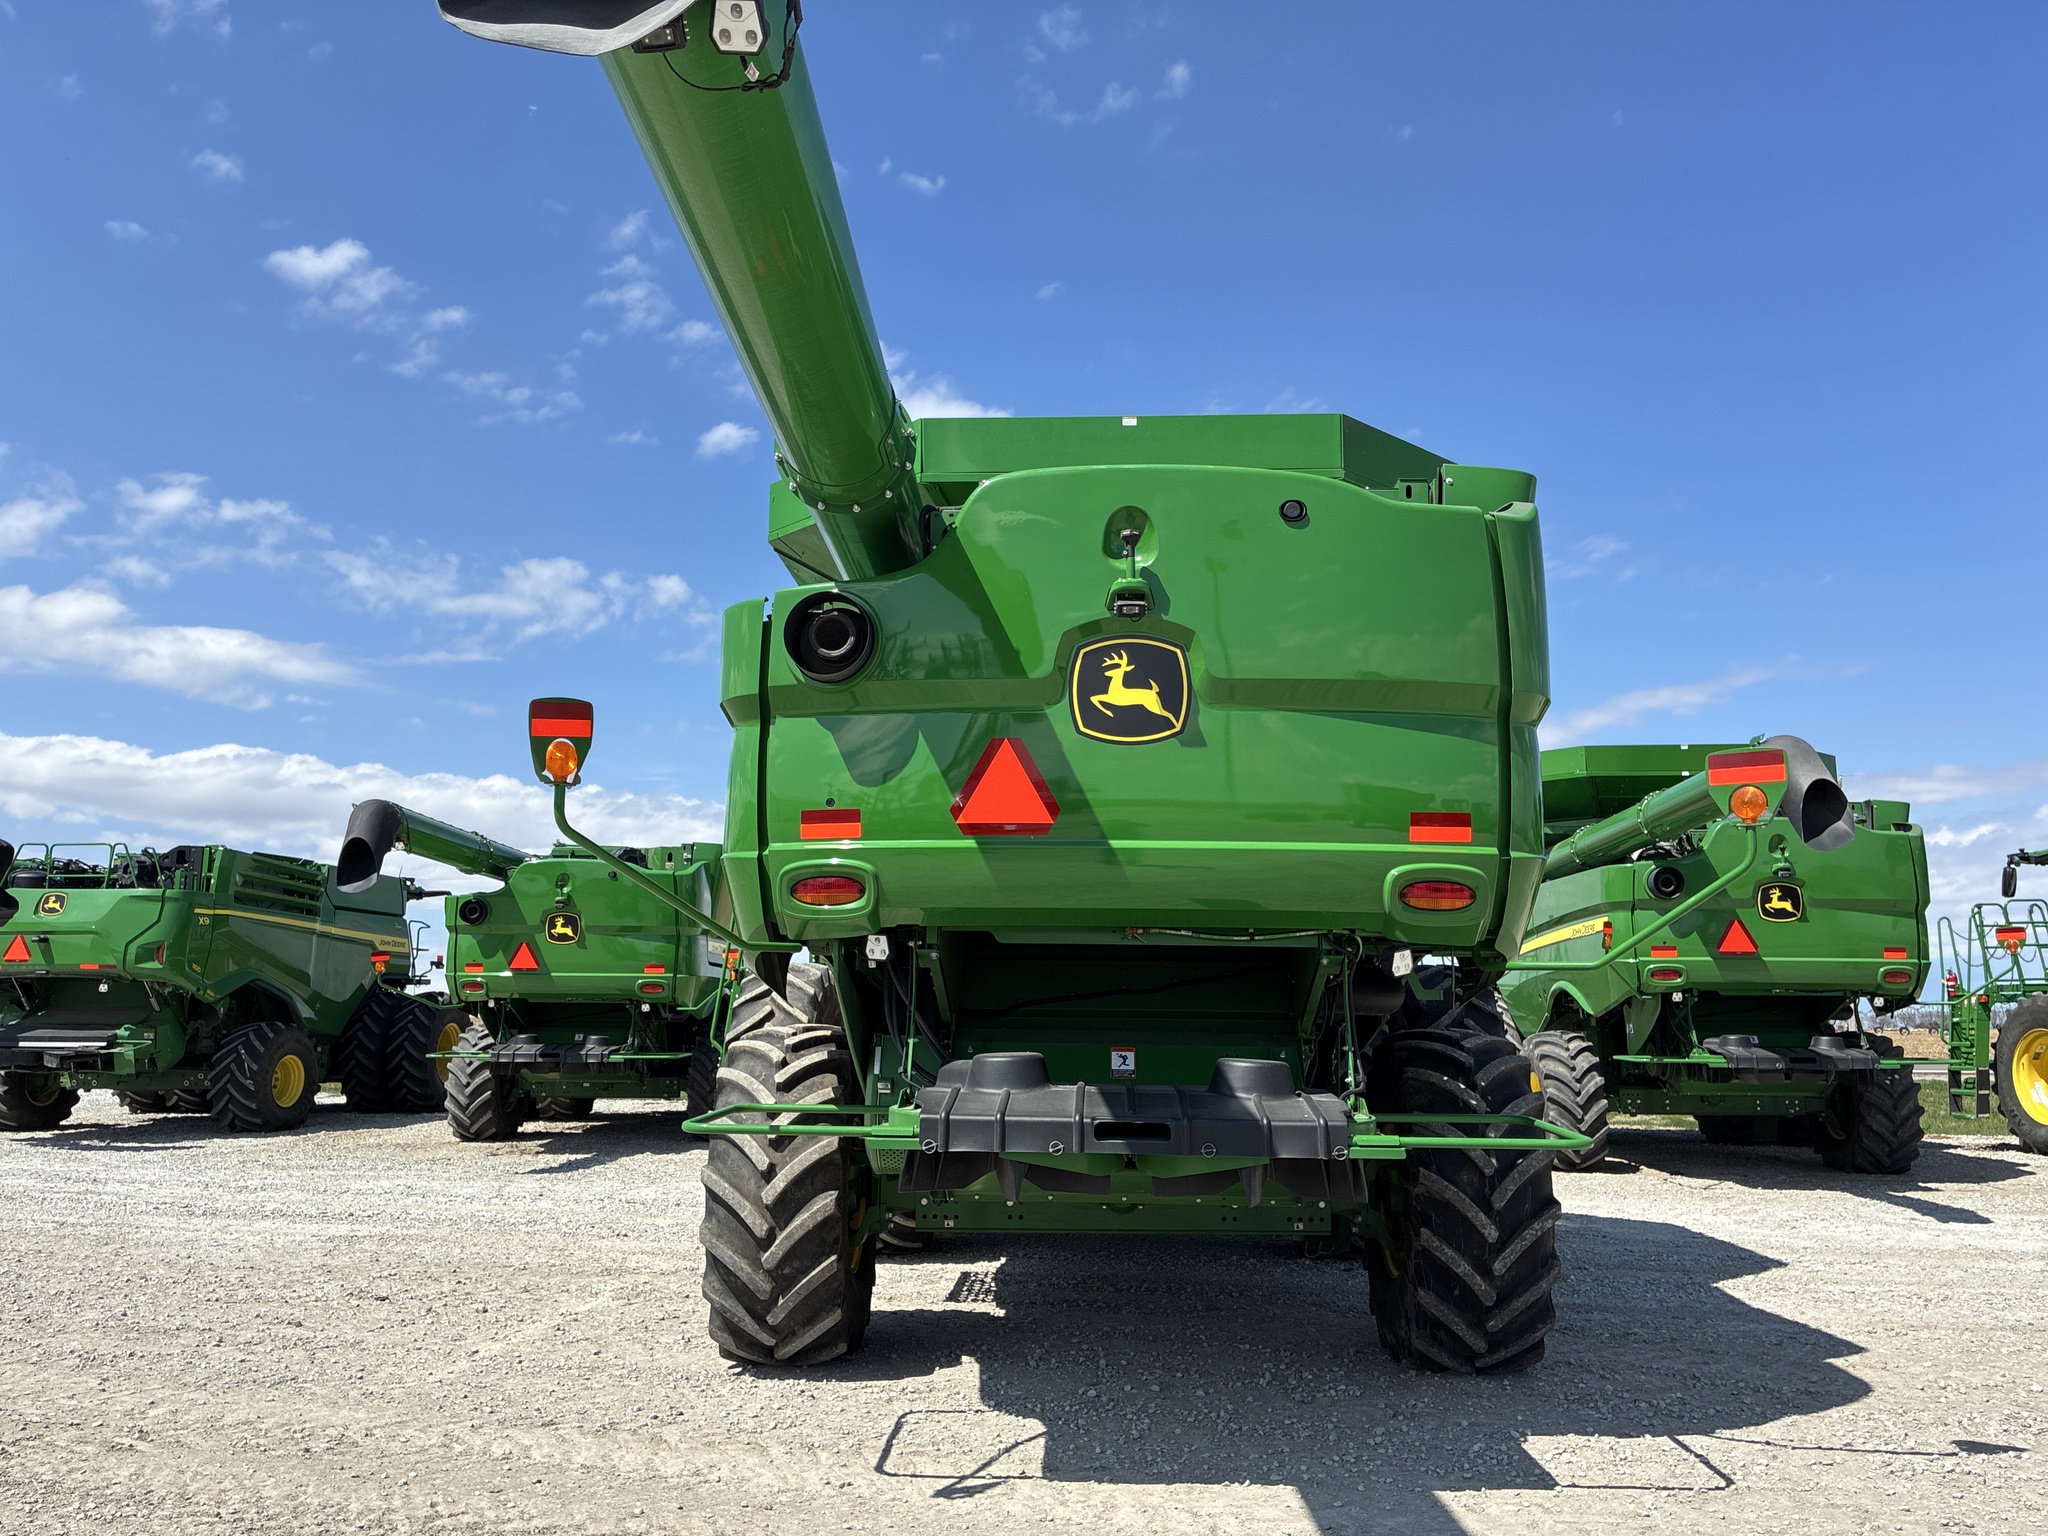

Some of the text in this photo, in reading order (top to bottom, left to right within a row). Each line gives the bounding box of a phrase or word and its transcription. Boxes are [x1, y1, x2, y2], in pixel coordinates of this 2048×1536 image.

[198, 916, 210, 926] X9
[1571, 923, 1595, 937] JOHN DEERE
[391, 940, 406, 948] DEERE
